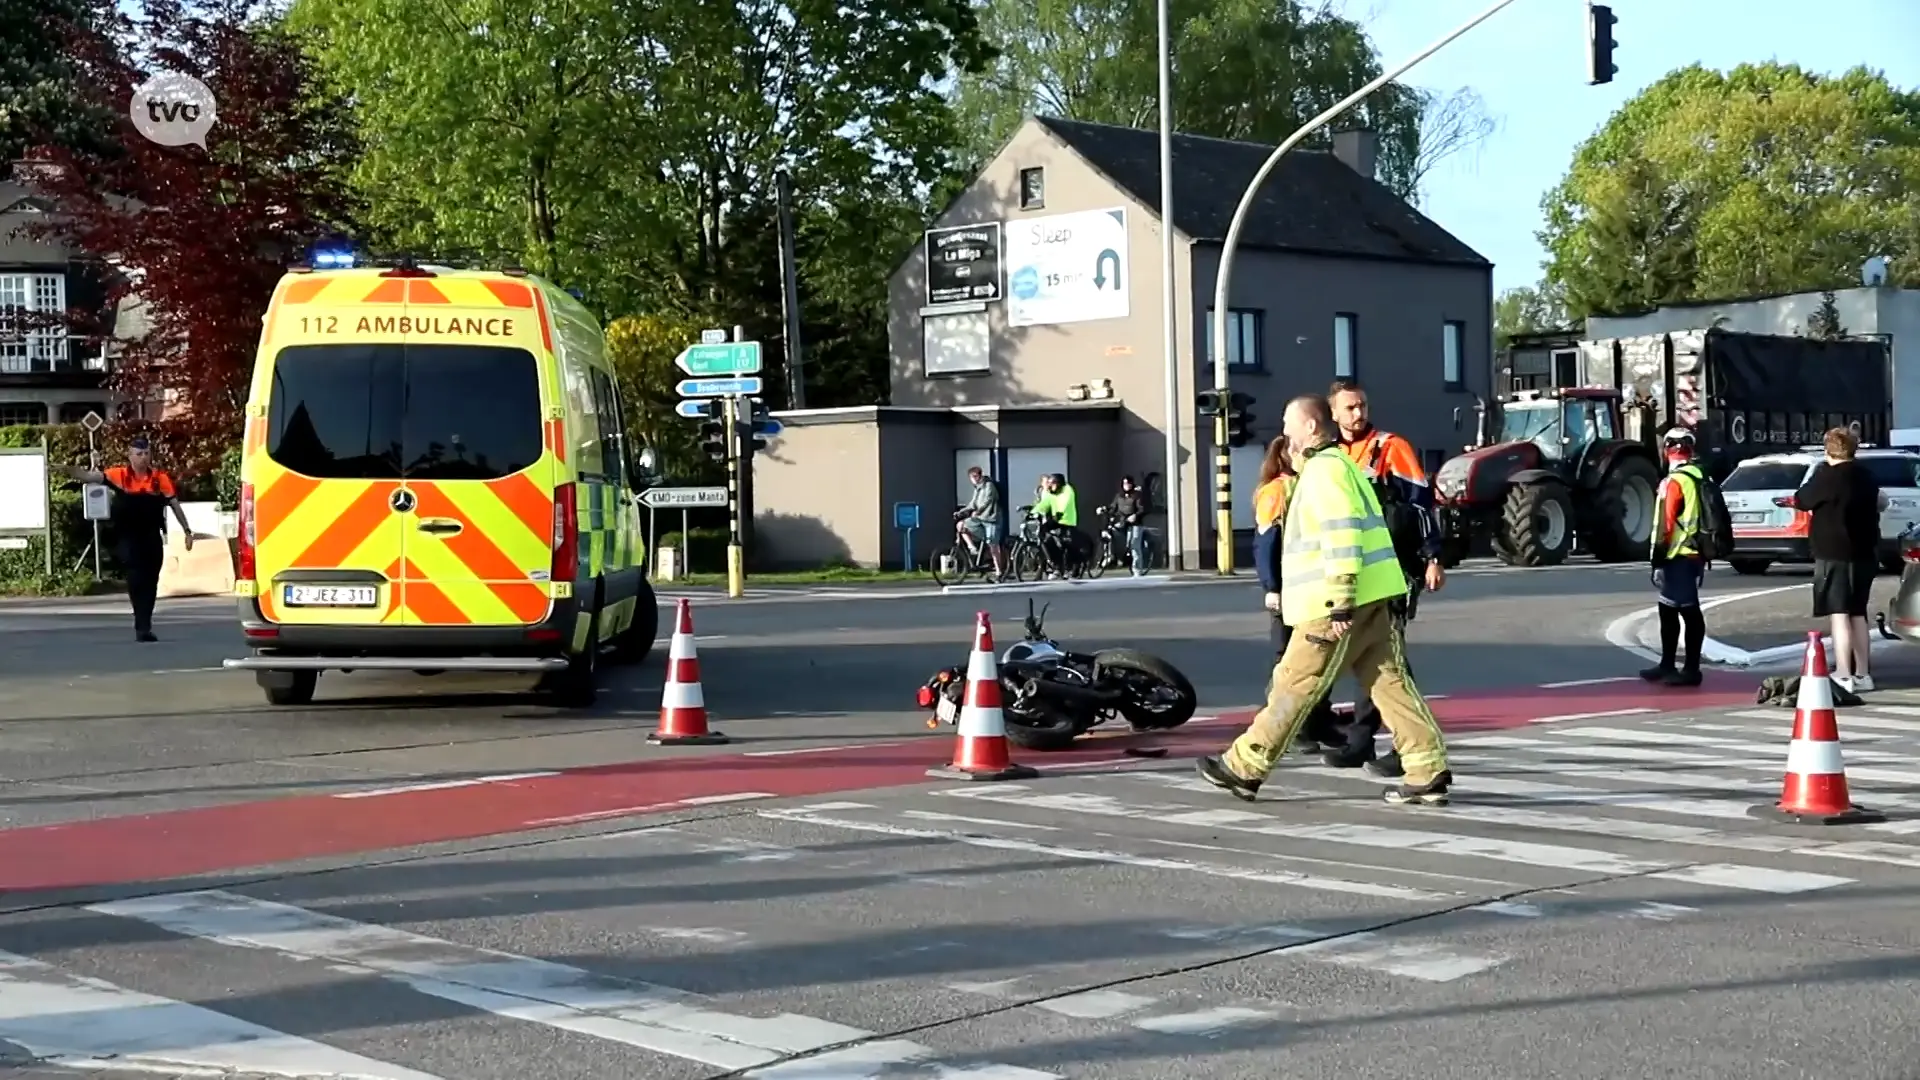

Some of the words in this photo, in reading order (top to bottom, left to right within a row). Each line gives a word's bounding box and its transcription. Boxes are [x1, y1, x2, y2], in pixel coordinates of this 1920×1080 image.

[1031, 222, 1072, 246] Sleep
[1046, 273, 1061, 287] 15
[300, 316, 338, 334] 112
[356, 316, 514, 336] AMBULANCE
[698, 491, 724, 502] Manta
